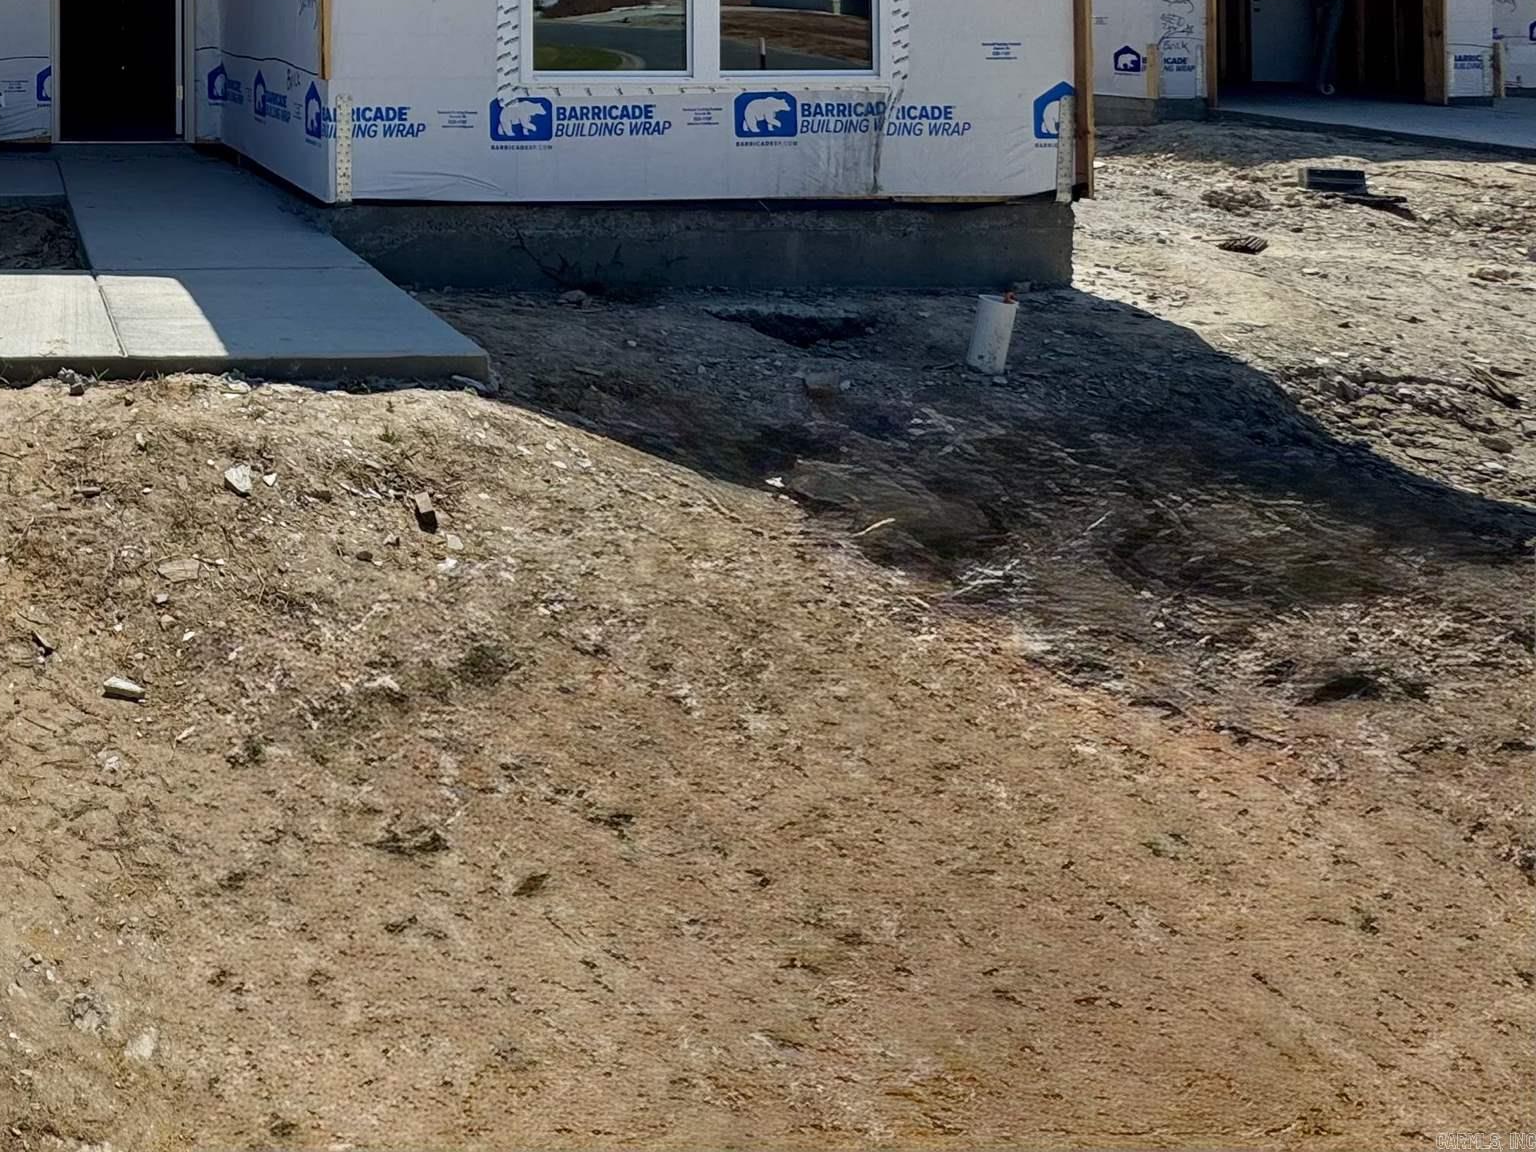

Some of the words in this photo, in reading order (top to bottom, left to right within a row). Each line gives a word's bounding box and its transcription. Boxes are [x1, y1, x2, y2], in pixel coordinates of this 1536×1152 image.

[556, 105, 654, 121] BARRICADE
[801, 101, 886, 118] BARRICAD
[383, 123, 426, 138] WRAP
[555, 121, 624, 137] BUILDING
[629, 120, 672, 136] WRAP
[800, 118, 869, 134] BUILDING
[927, 122, 972, 136] WRAP
